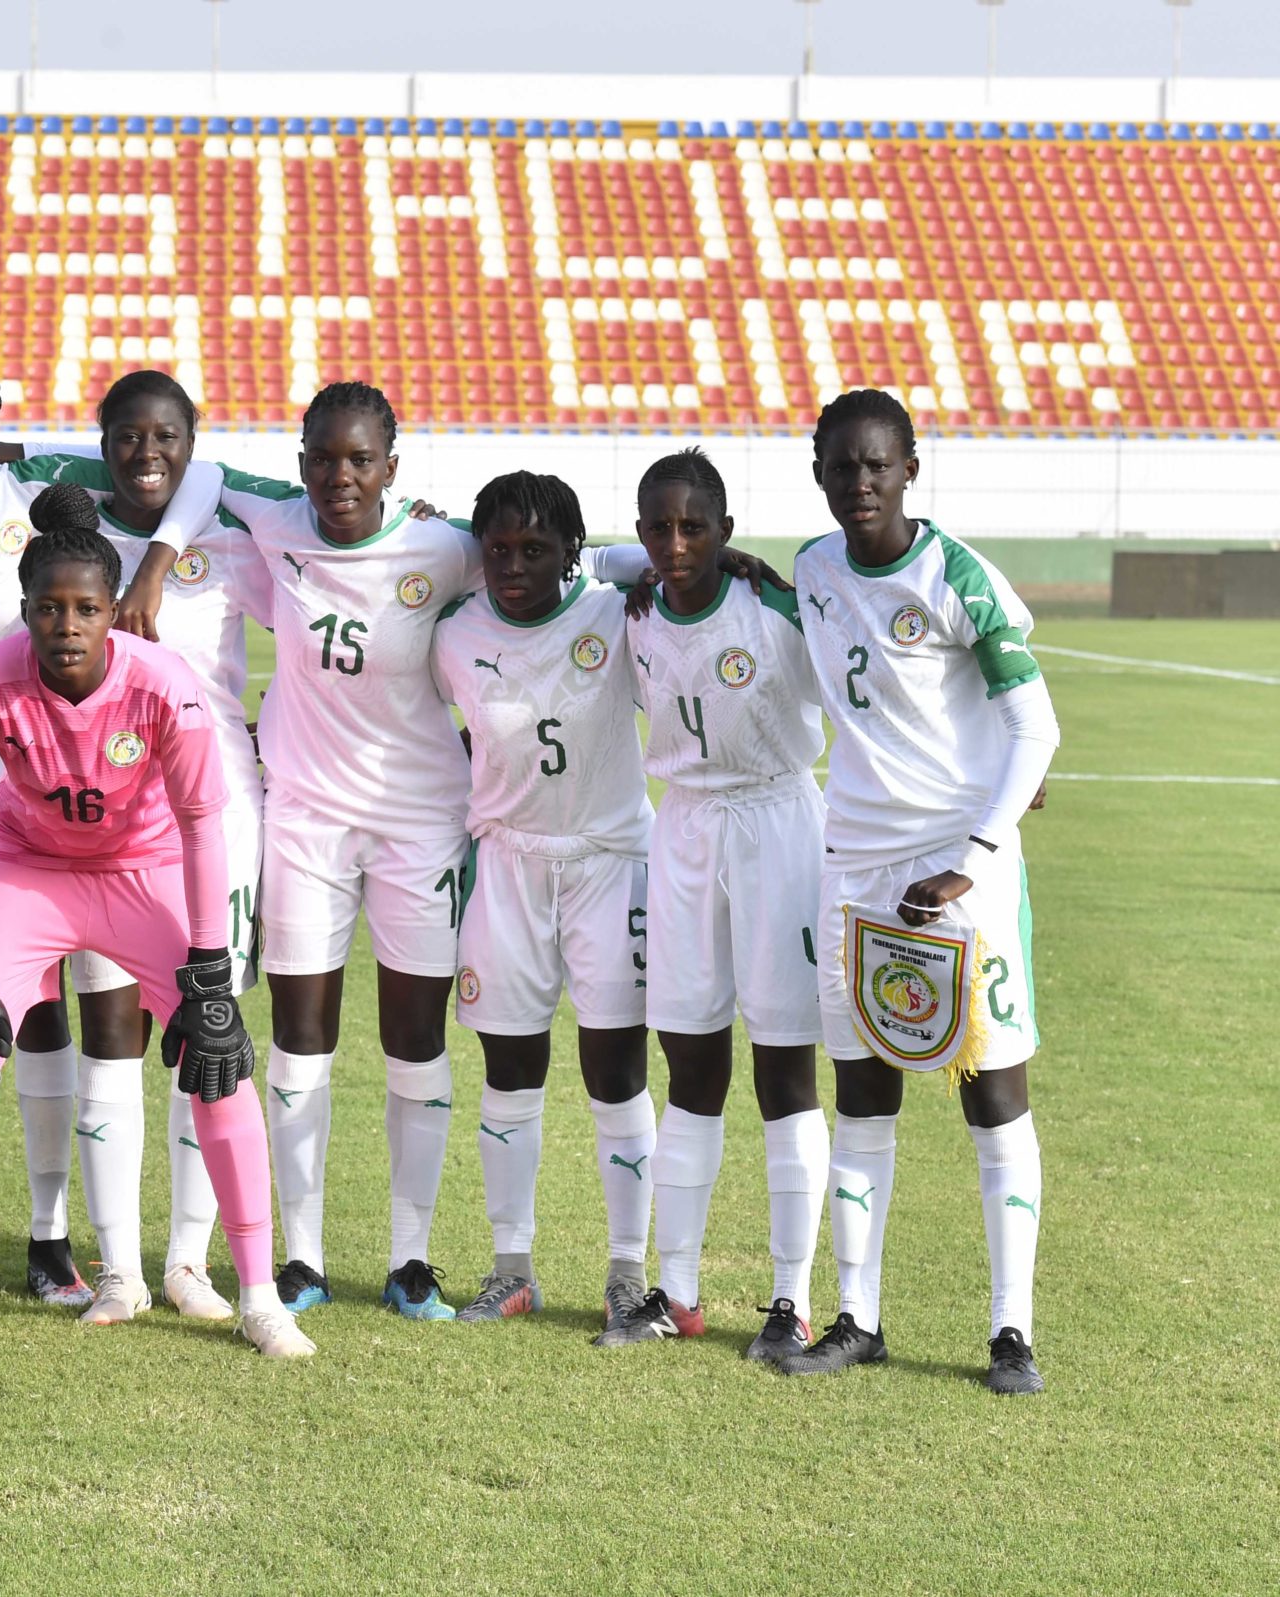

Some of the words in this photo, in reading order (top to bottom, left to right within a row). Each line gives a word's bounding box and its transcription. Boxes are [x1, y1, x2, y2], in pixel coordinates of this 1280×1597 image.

[6, 135, 903, 280] STADE
[541, 297, 1136, 413] DIOR
[309, 613, 368, 675] 15
[847, 645, 870, 710] 2
[537, 719, 567, 776] 5
[678, 696, 708, 758] 4
[44, 786, 104, 823] 16
[898, 954, 927, 966] FOOTBALL
[982, 956, 1014, 1022] 2
